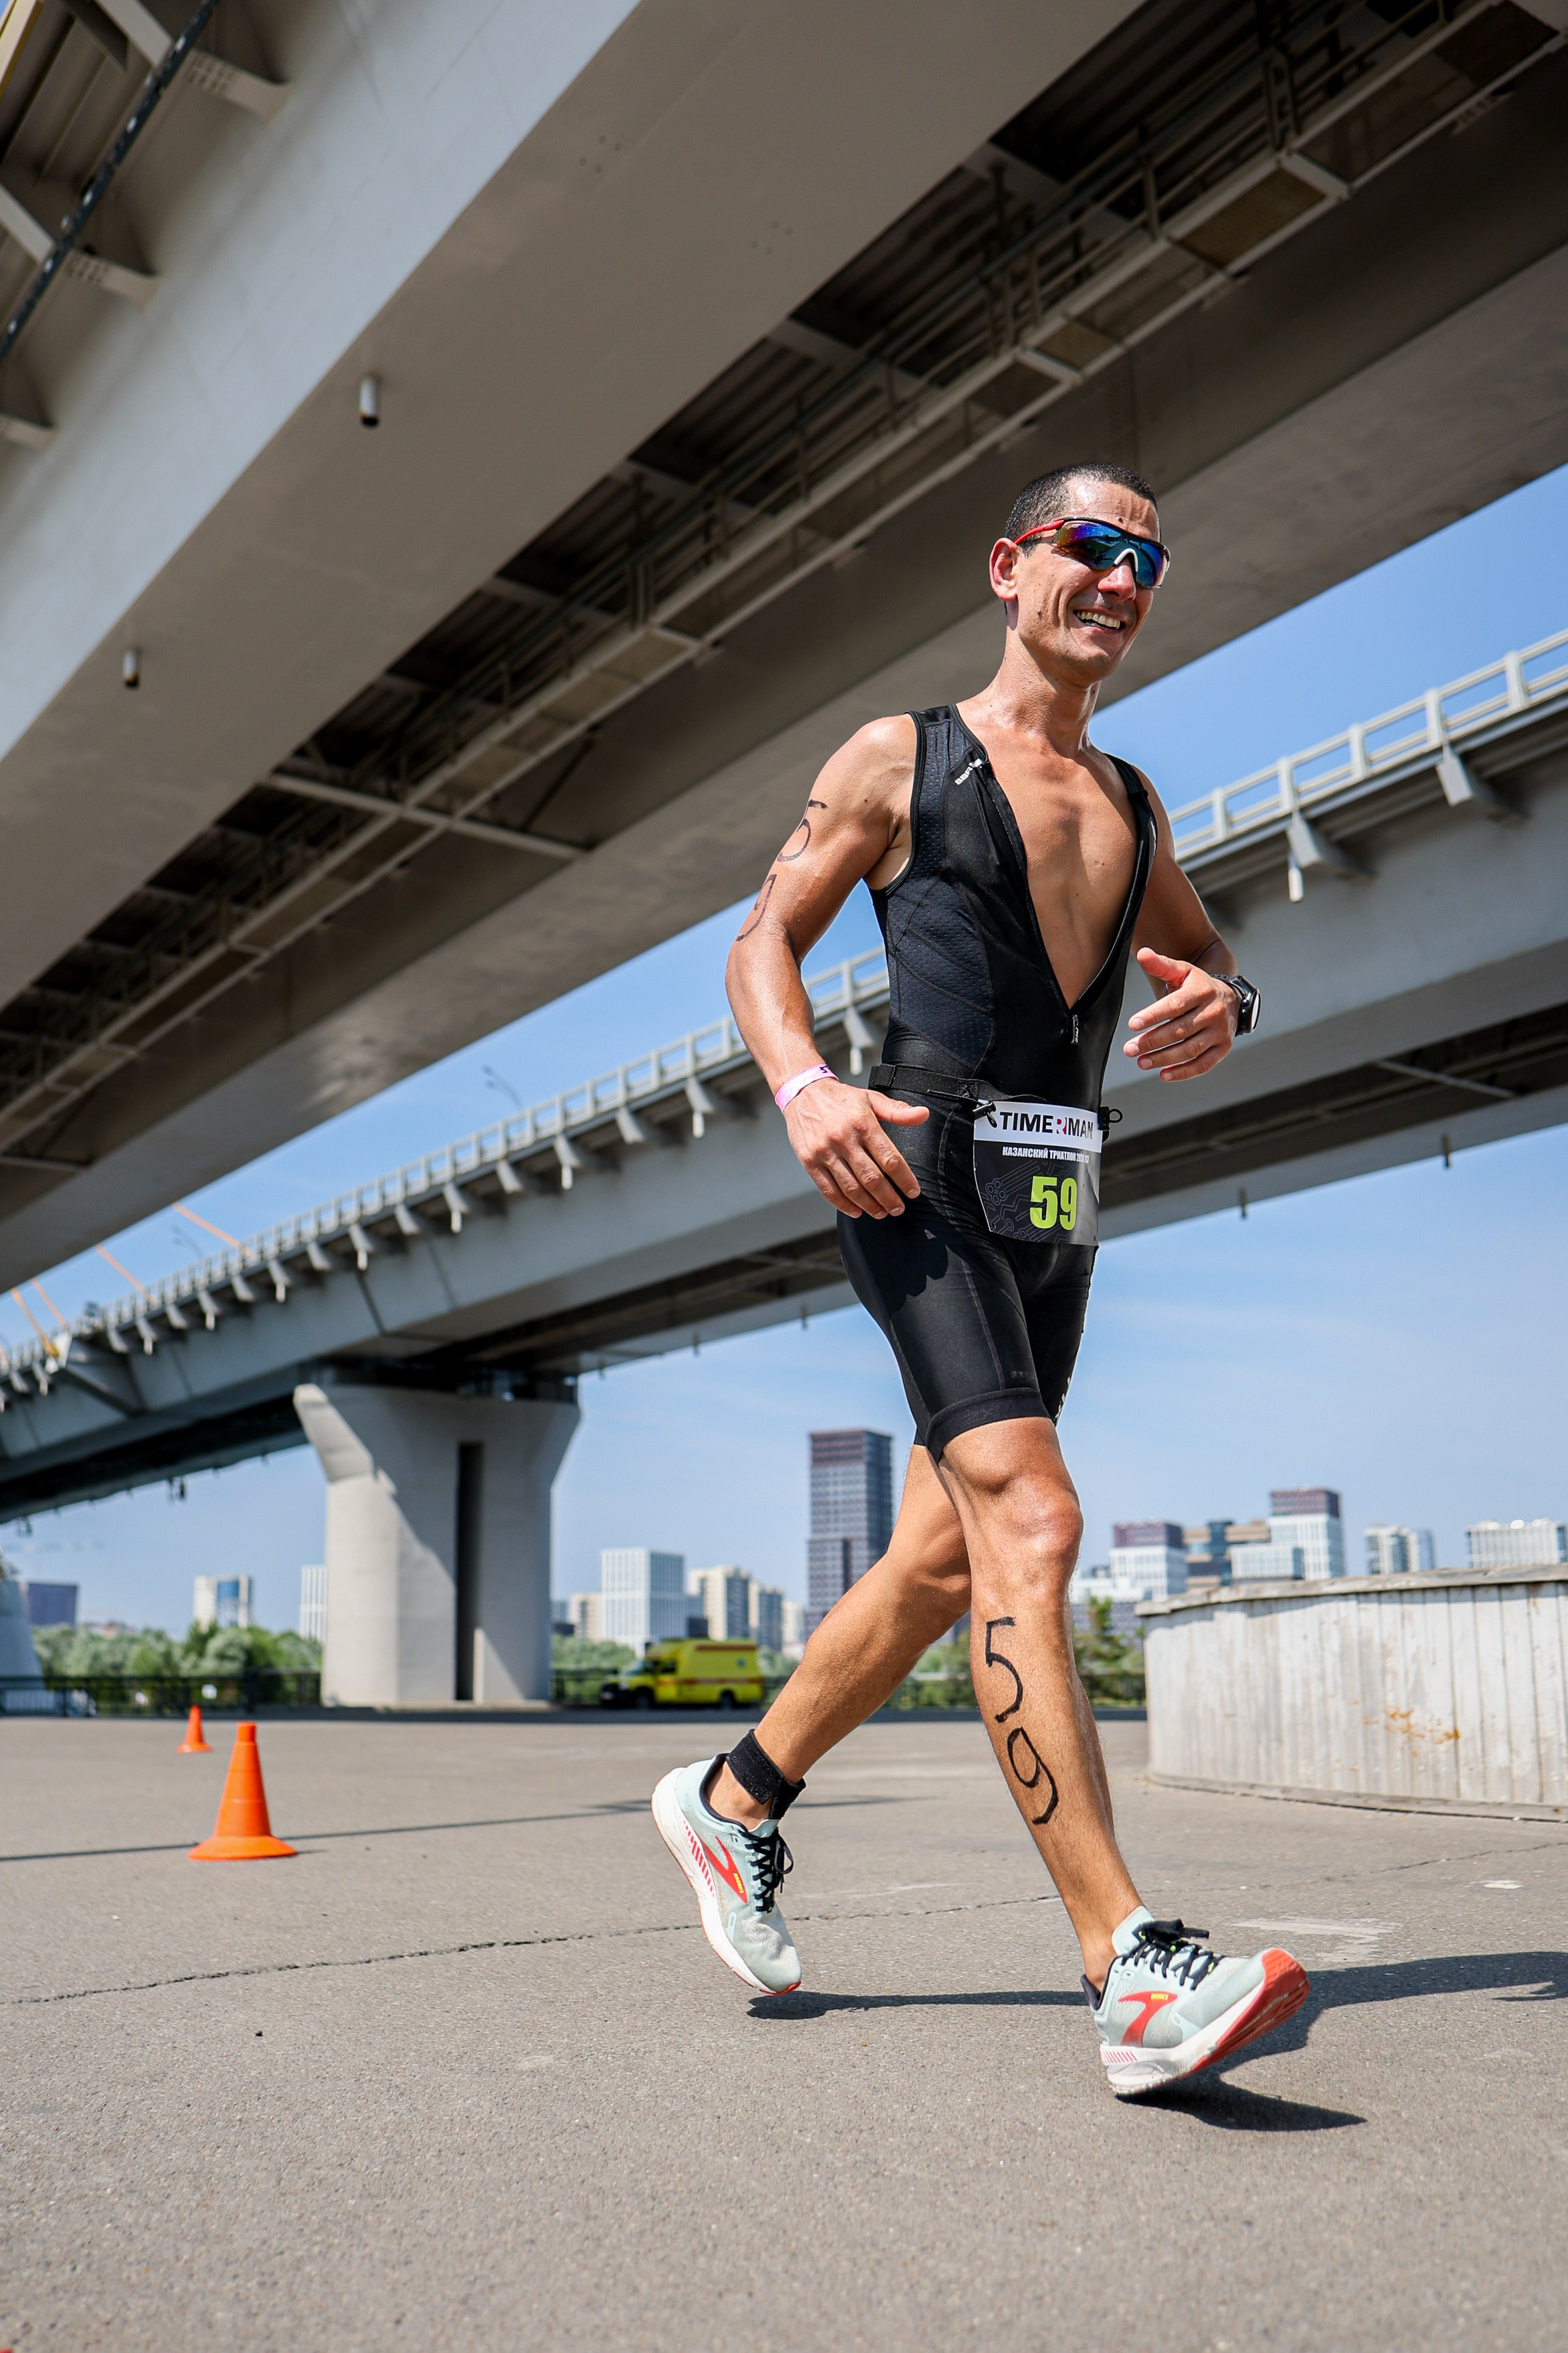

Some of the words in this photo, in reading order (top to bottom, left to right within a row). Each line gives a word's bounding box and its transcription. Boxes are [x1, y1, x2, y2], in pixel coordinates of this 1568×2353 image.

[999, 1112, 1093, 1139] TIMERMAN
[1002, 1146, 1048, 1159] КАЗАНСКИЙ
[1049, 1149, 1076, 1161] ТРИАТЛОН
[1029, 1175, 1078, 1230] 59
[985, 1616, 1059, 1825] 59
[733, 1872, 744, 1894] BROOKS
